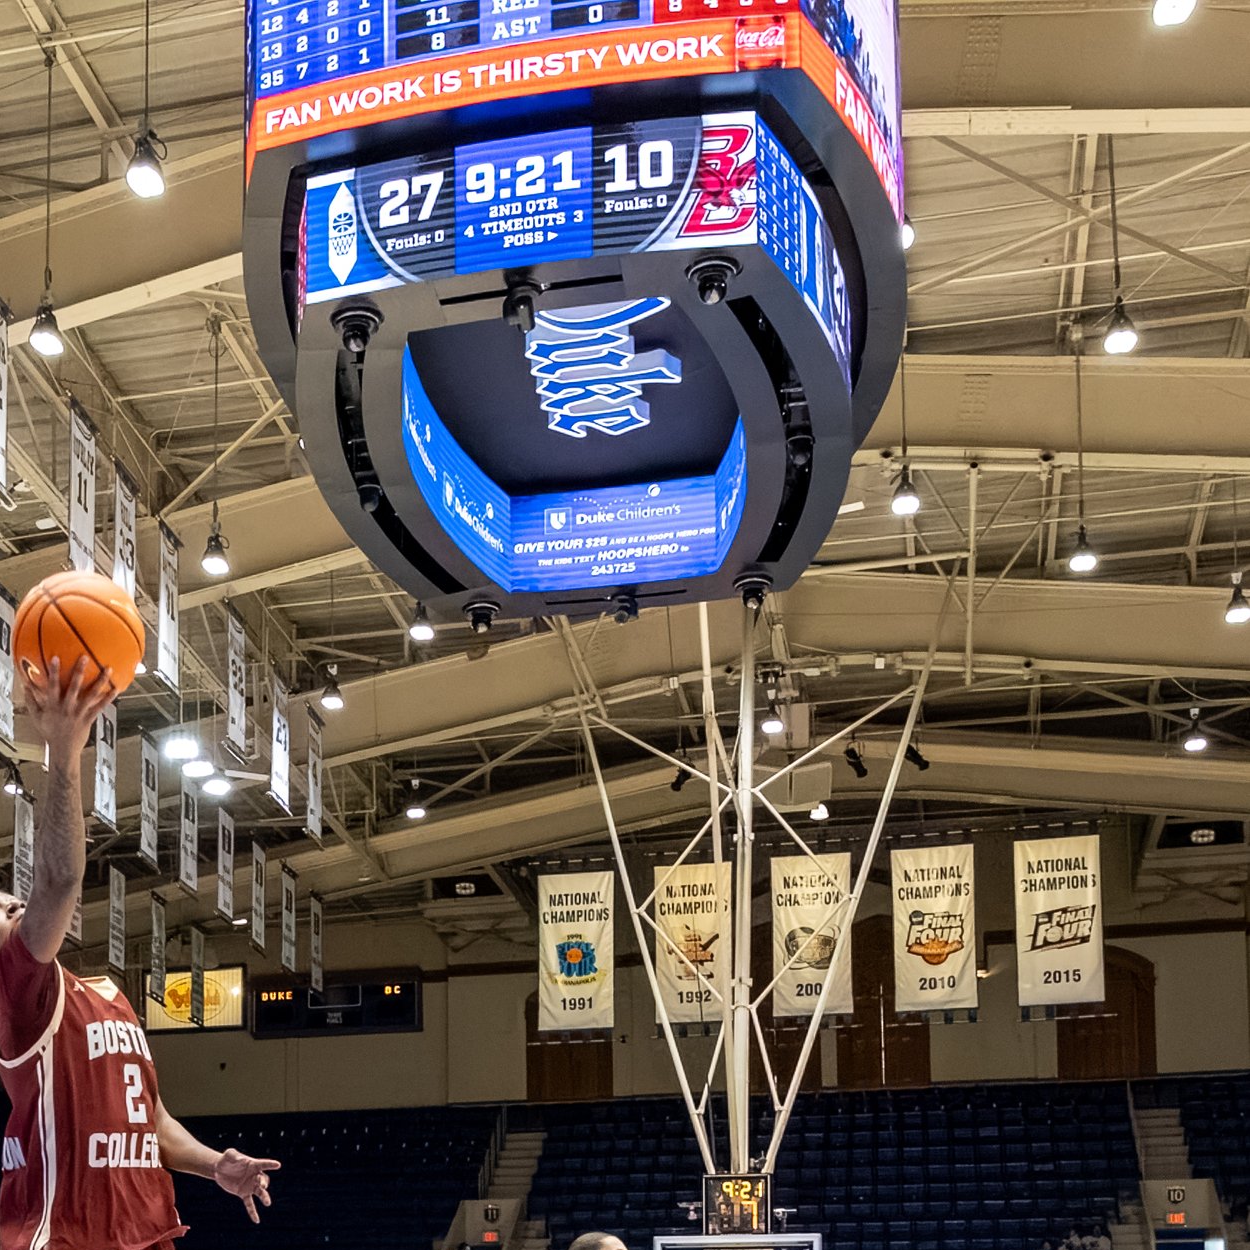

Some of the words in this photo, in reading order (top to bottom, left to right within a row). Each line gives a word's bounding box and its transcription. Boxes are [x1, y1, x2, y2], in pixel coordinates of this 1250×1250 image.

[261, 15, 284, 35] 12
[296, 8, 309, 24] 4
[327, 0, 339, 17] 2
[426, 6, 451, 26] 11
[588, 5, 603, 23] 0
[492, 16, 541, 41] AST
[261, 43, 284, 62] 13
[297, 35, 309, 53] 2
[326, 27, 339, 44] 0
[358, 20, 371, 37] 0
[431, 32, 446, 50] 8
[260, 70, 284, 90] 35
[296, 62, 309, 80] 7
[326, 54, 339, 72] 2
[358, 48, 370, 64] 1
[264, 98, 321, 134] FAN
[328, 75, 427, 118] WORK
[433, 70, 462, 95] IS
[467, 45, 610, 89] THIRSTY
[615, 34, 724, 67] WORK
[835, 67, 869, 145] FAN
[604, 140, 673, 193] 10
[465, 150, 581, 203] 9:21
[379, 171, 444, 228] 27
[489, 202, 522, 219] 2ND
[525, 197, 559, 213] QTR
[604, 197, 653, 214] Fouls:
[656, 194, 667, 207] 0
[464, 225, 475, 238] 4
[480, 213, 566, 235] TIMEOUTS
[573, 210, 584, 223] 3
[386, 232, 431, 252] Fouls:
[435, 230, 445, 243] 0
[503, 231, 544, 249] POSS
[77, 471, 88, 513] 11
[576, 510, 615, 525] Duke
[617, 503, 681, 522] Children's
[514, 543, 545, 554] GIVE
[547, 539, 583, 551] YOUR
[585, 536, 608, 549] $25
[597, 544, 679, 561] HOOPSHERO
[591, 562, 636, 576] 243725
[904, 865, 962, 883] NATIONAL
[1027, 856, 1088, 874] NATIONAL
[666, 883, 715, 898] NATIONA
[898, 883, 970, 900] CHAMPIONS
[1021, 874, 1097, 892] CHAMPIONS
[549, 890, 603, 907] NATIONAL
[543, 908, 610, 924] CHAMPIONS
[924, 912, 963, 928] FINAL
[1052, 905, 1093, 925] FINAL
[908, 927, 964, 947] FOUR
[1034, 918, 1092, 947] FOUR
[919, 975, 956, 990] 2010
[1043, 969, 1081, 984] 2015
[261, 991, 293, 1002] DUKE
[796, 983, 823, 997] 200
[561, 997, 593, 1011] 1991
[123, 1063, 147, 1124] 2
[722, 1180, 763, 1199] 9:21
[1170, 1190, 1184, 1201] 10
